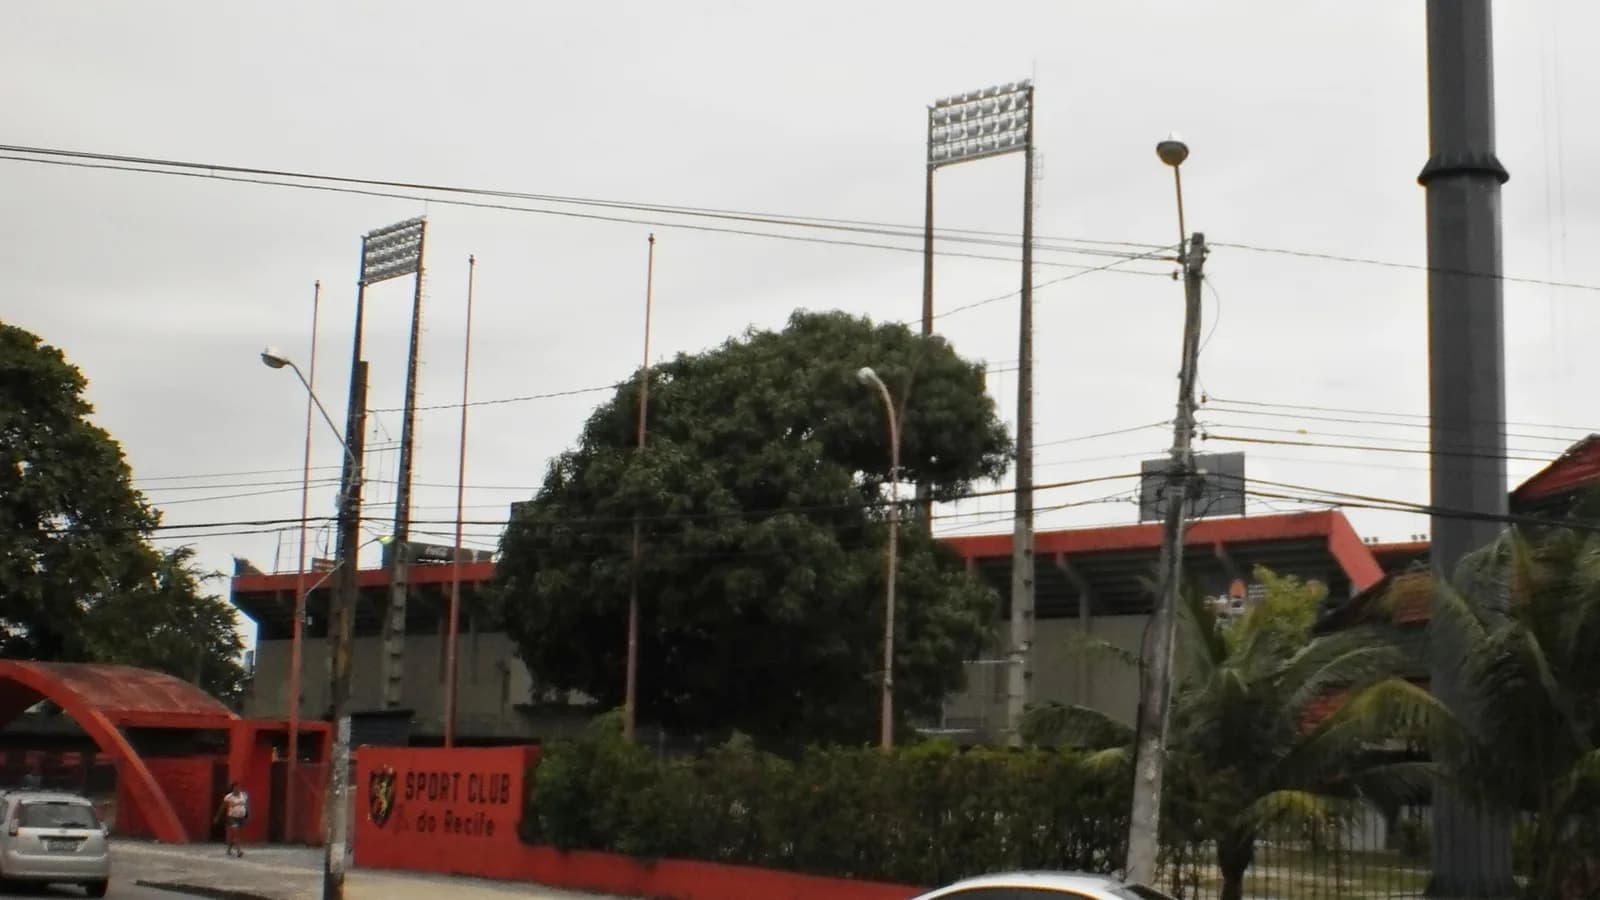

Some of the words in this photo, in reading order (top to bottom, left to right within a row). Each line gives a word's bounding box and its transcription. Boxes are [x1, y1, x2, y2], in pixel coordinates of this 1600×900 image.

[405, 771, 461, 802] SPORT
[467, 773, 510, 804] CLUB
[416, 811, 436, 833] do
[444, 810, 495, 837] Recife
